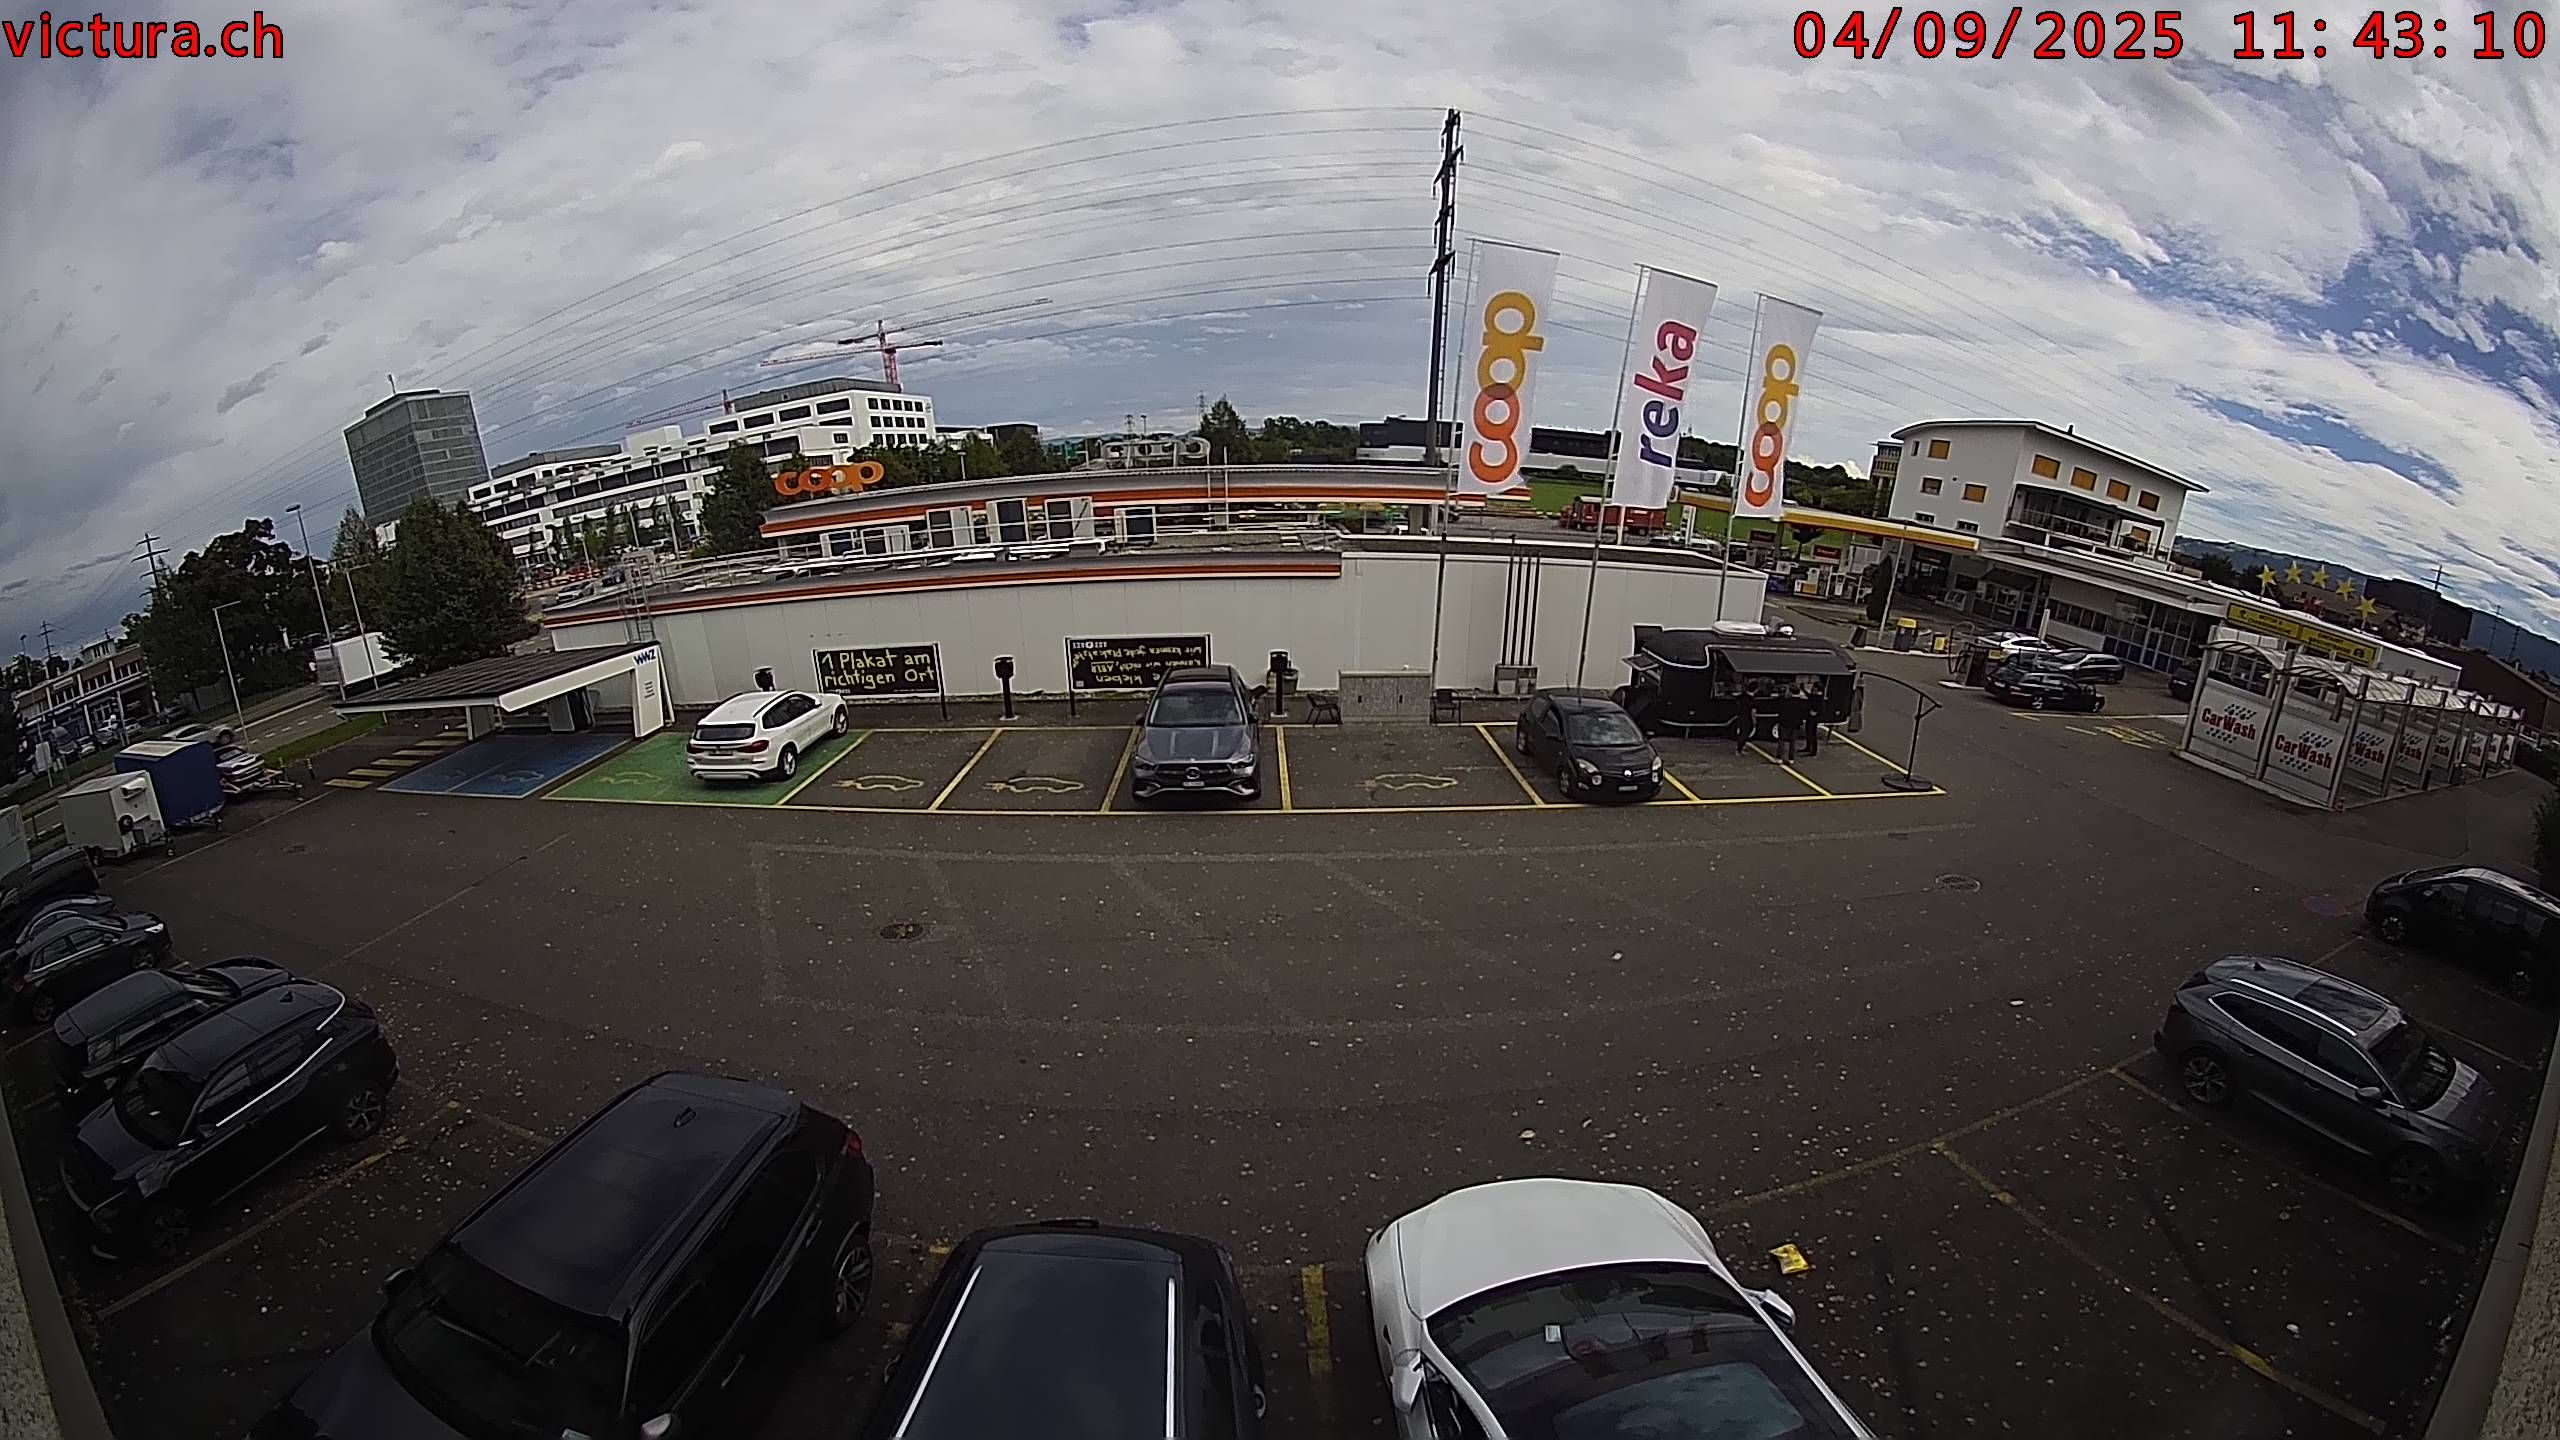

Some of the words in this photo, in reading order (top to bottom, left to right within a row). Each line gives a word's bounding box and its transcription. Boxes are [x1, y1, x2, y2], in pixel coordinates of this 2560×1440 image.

[1469, 291, 1544, 483] coop
[1634, 320, 1697, 468] reka
[1745, 344, 1799, 507] coop
[774, 461, 884, 496] coop
[633, 648, 656, 665] WWZ
[822, 653, 833, 669] 1
[840, 649, 897, 669] Plakat
[904, 654, 931, 665] am
[1091, 662, 1114, 673] ABER
[824, 669, 895, 689] richtigen
[904, 666, 935, 682] Ort
[1096, 673, 1143, 684] kleben
[2201, 707, 2256, 740] CarWash
[2274, 734, 2333, 769] CarWash
[2352, 741, 2385, 764] Wash
